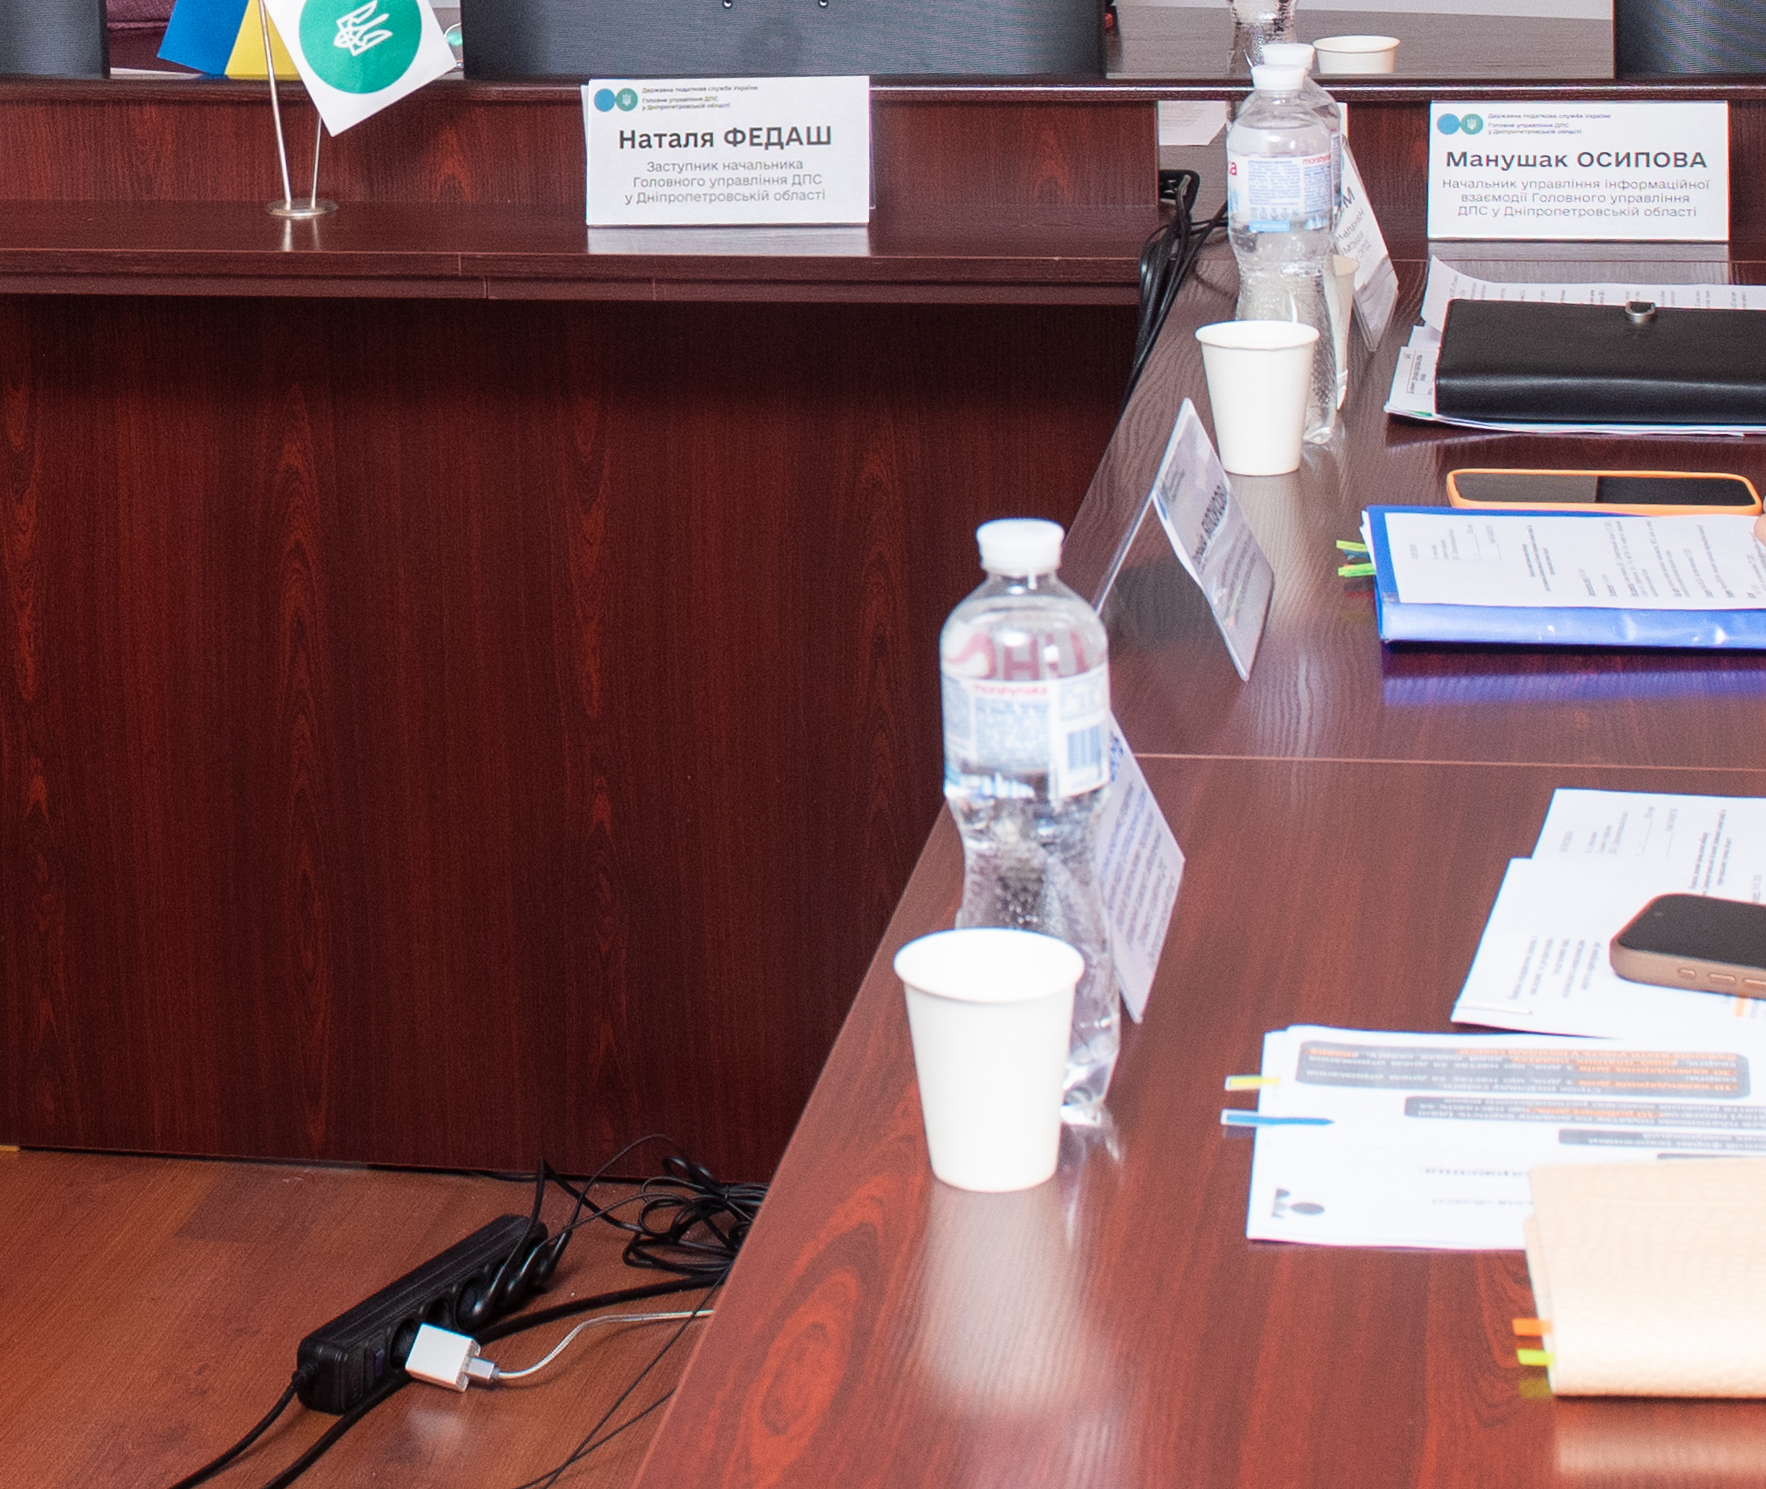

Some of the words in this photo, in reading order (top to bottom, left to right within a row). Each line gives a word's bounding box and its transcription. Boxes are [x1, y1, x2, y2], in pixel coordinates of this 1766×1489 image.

[619, 130, 714, 149] Наталя
[724, 126, 831, 150] ФЕДАШ
[647, 161, 718, 174] Заступник
[722, 161, 803, 171] начальника
[1446, 152, 1568, 171] Манушак
[1577, 152, 1707, 168] ОСИПОВА
[633, 177, 705, 188] Головного
[709, 175, 787, 188] управління
[792, 174, 822, 186] ДПС
[1442, 179, 1516, 189] Начальник
[1521, 179, 1600, 192] управління
[1605, 178, 1710, 192] інформаційної
[637, 191, 769, 205] Дніпропетровській
[774, 189, 825, 201] області
[1461, 193, 1527, 203] взаємодії
[1532, 193, 1606, 203] Головного
[1610, 193, 1690, 205] управління
[1458, 206, 1488, 217] ДПС
[1504, 206, 1639, 218] Дніпропетровській
[1644, 206, 1697, 216] області
